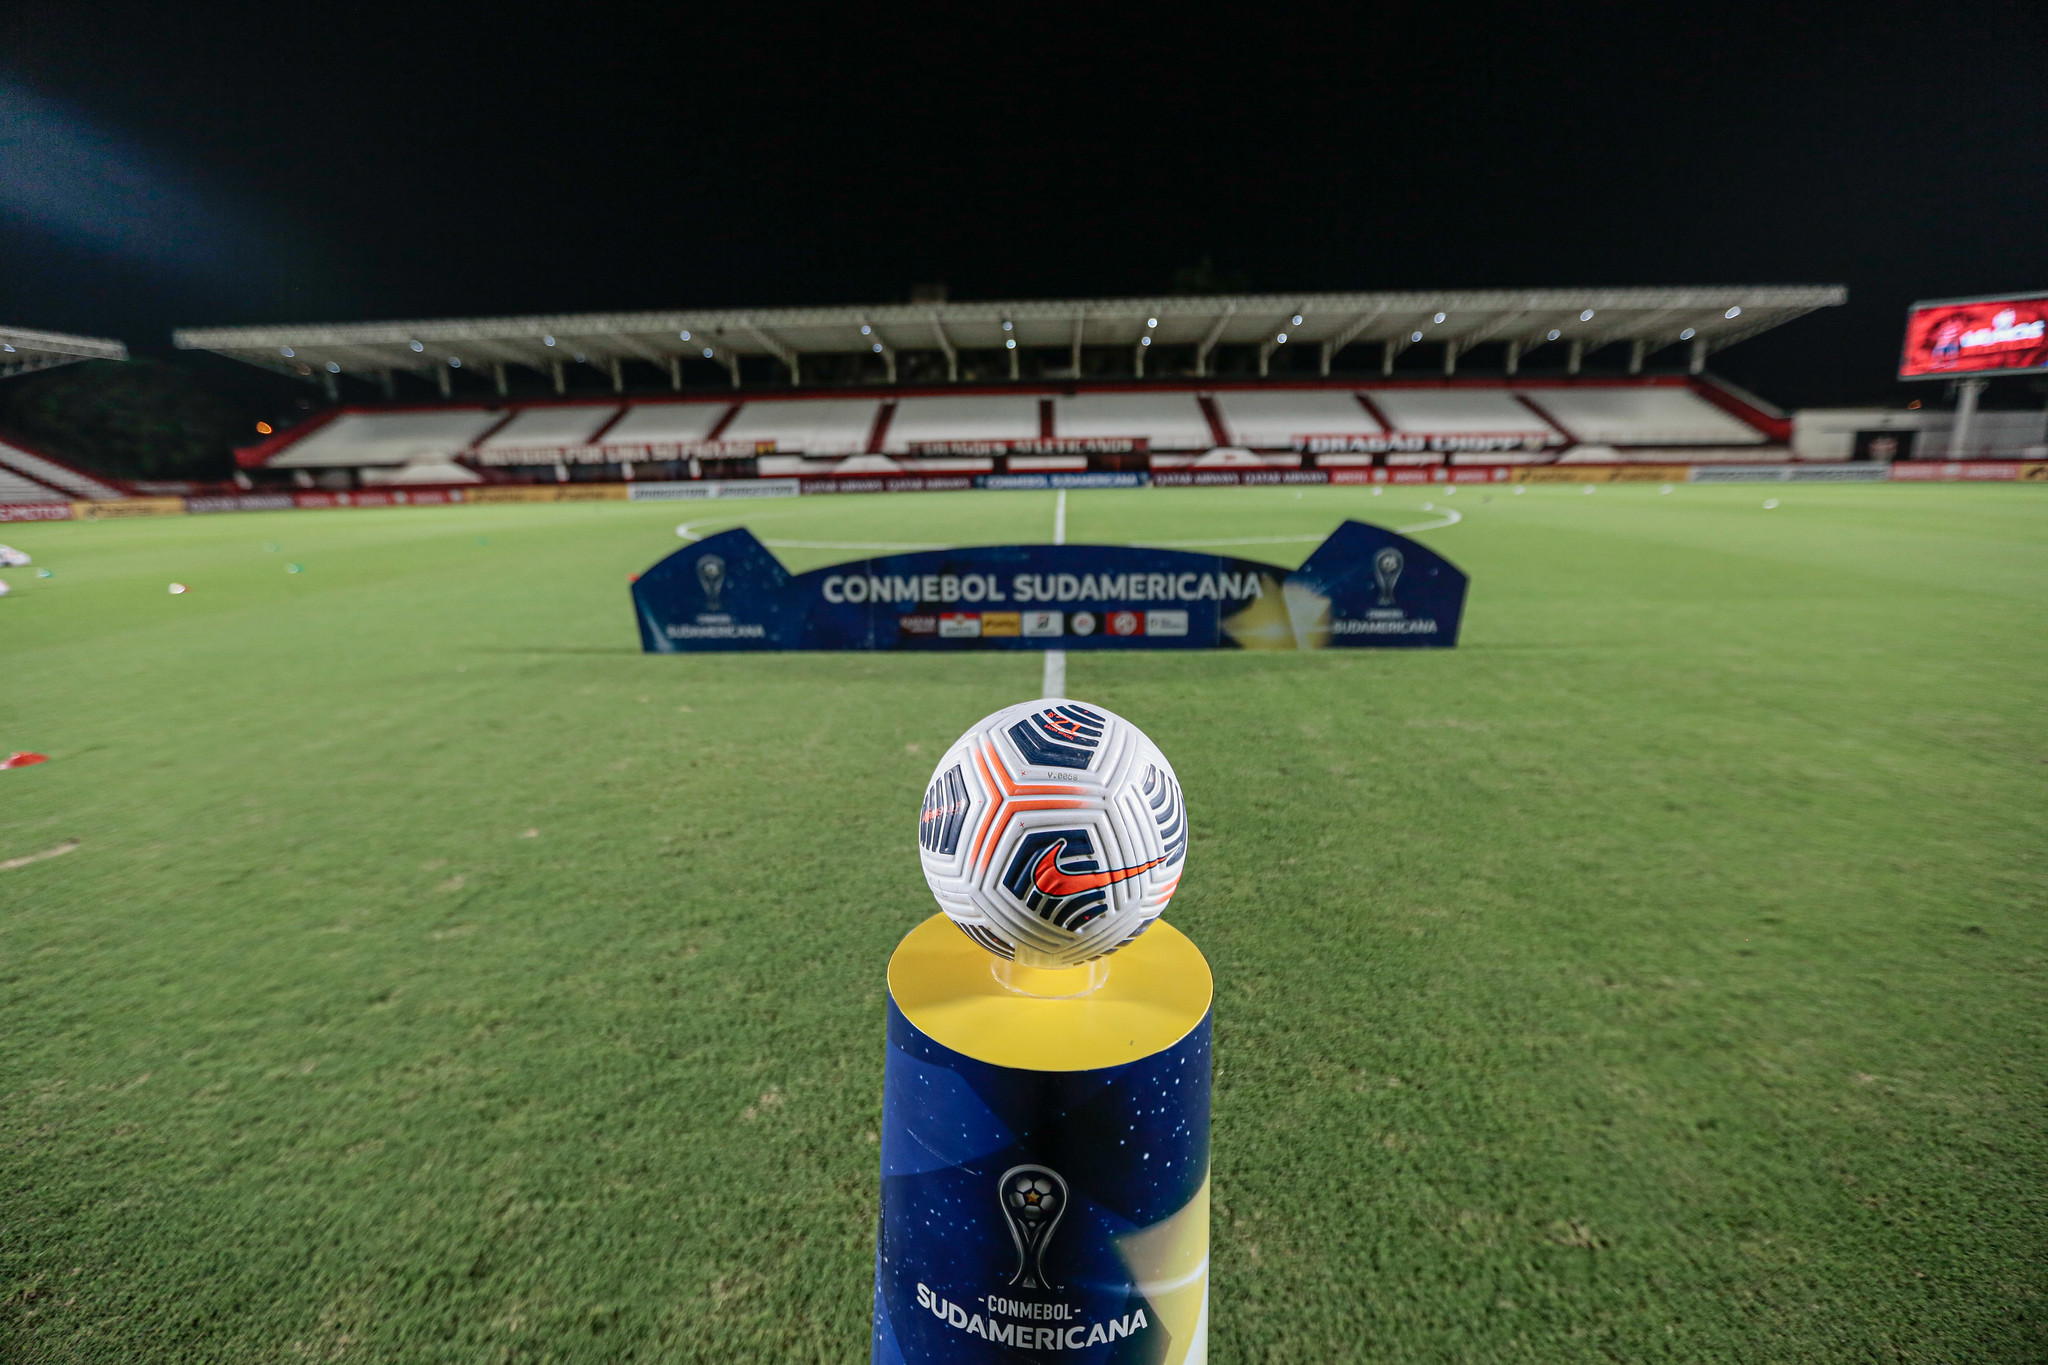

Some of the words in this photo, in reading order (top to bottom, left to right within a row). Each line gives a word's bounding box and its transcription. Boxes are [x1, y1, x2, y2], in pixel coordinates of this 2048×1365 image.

[1050, 473, 1138, 487] SUDAMERICANA
[1155, 474, 1193, 486] QATAR
[1195, 472, 1240, 485] AIRWAYS
[1244, 473, 1281, 485] QATAR
[1283, 471, 1328, 484] AIRWAYS
[822, 574, 1006, 603] CONMEBOL
[1013, 573, 1264, 602] SUDAMERICANA
[666, 623, 766, 639] SUDAMERICANA
[1333, 619, 1439, 635] SUDAMERICANA
[987, 1294, 1073, 1320] CONMEBOL
[917, 1282, 1149, 1350] SUDAMERICANA
